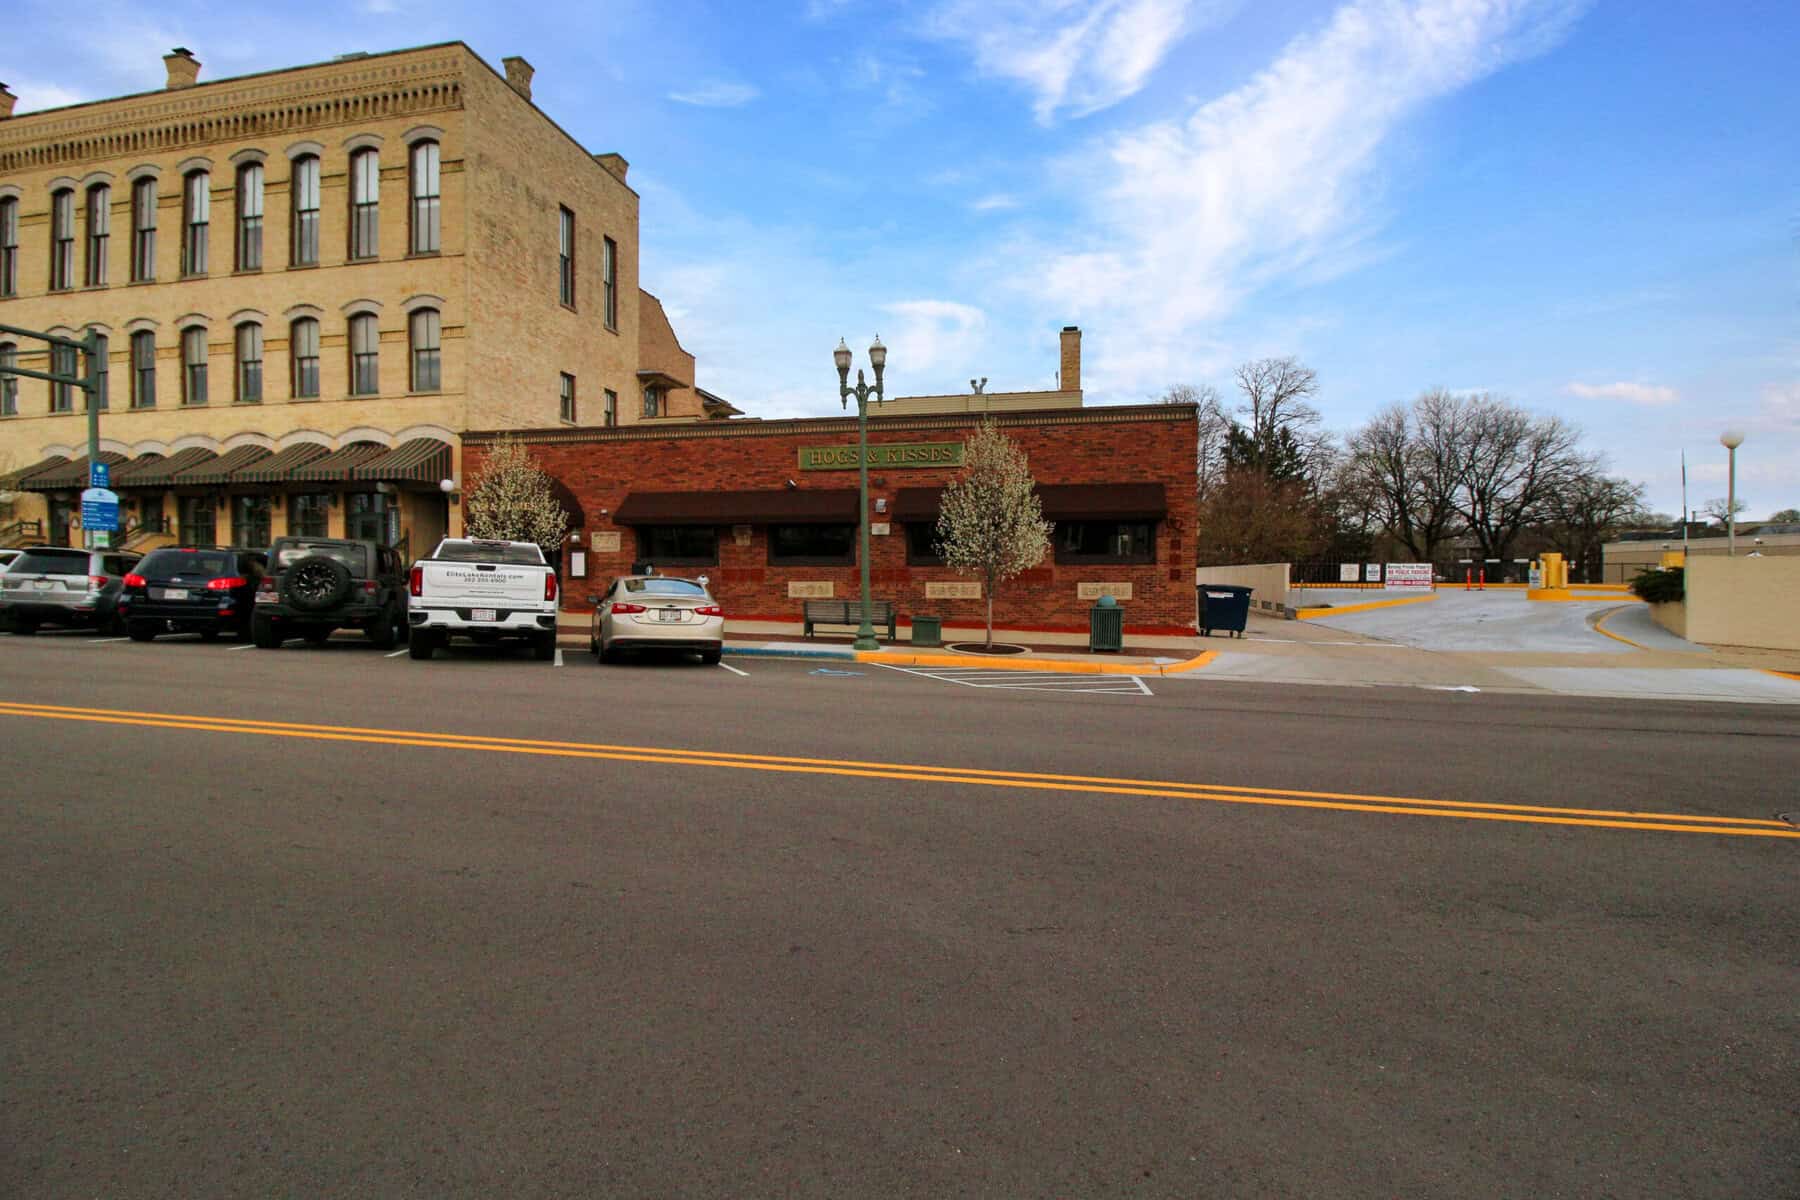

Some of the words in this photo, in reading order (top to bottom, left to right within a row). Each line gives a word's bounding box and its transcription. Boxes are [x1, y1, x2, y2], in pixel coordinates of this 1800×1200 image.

[809, 449, 860, 465] HOGS
[867, 449, 880, 464] &
[887, 447, 953, 463] KISSES
